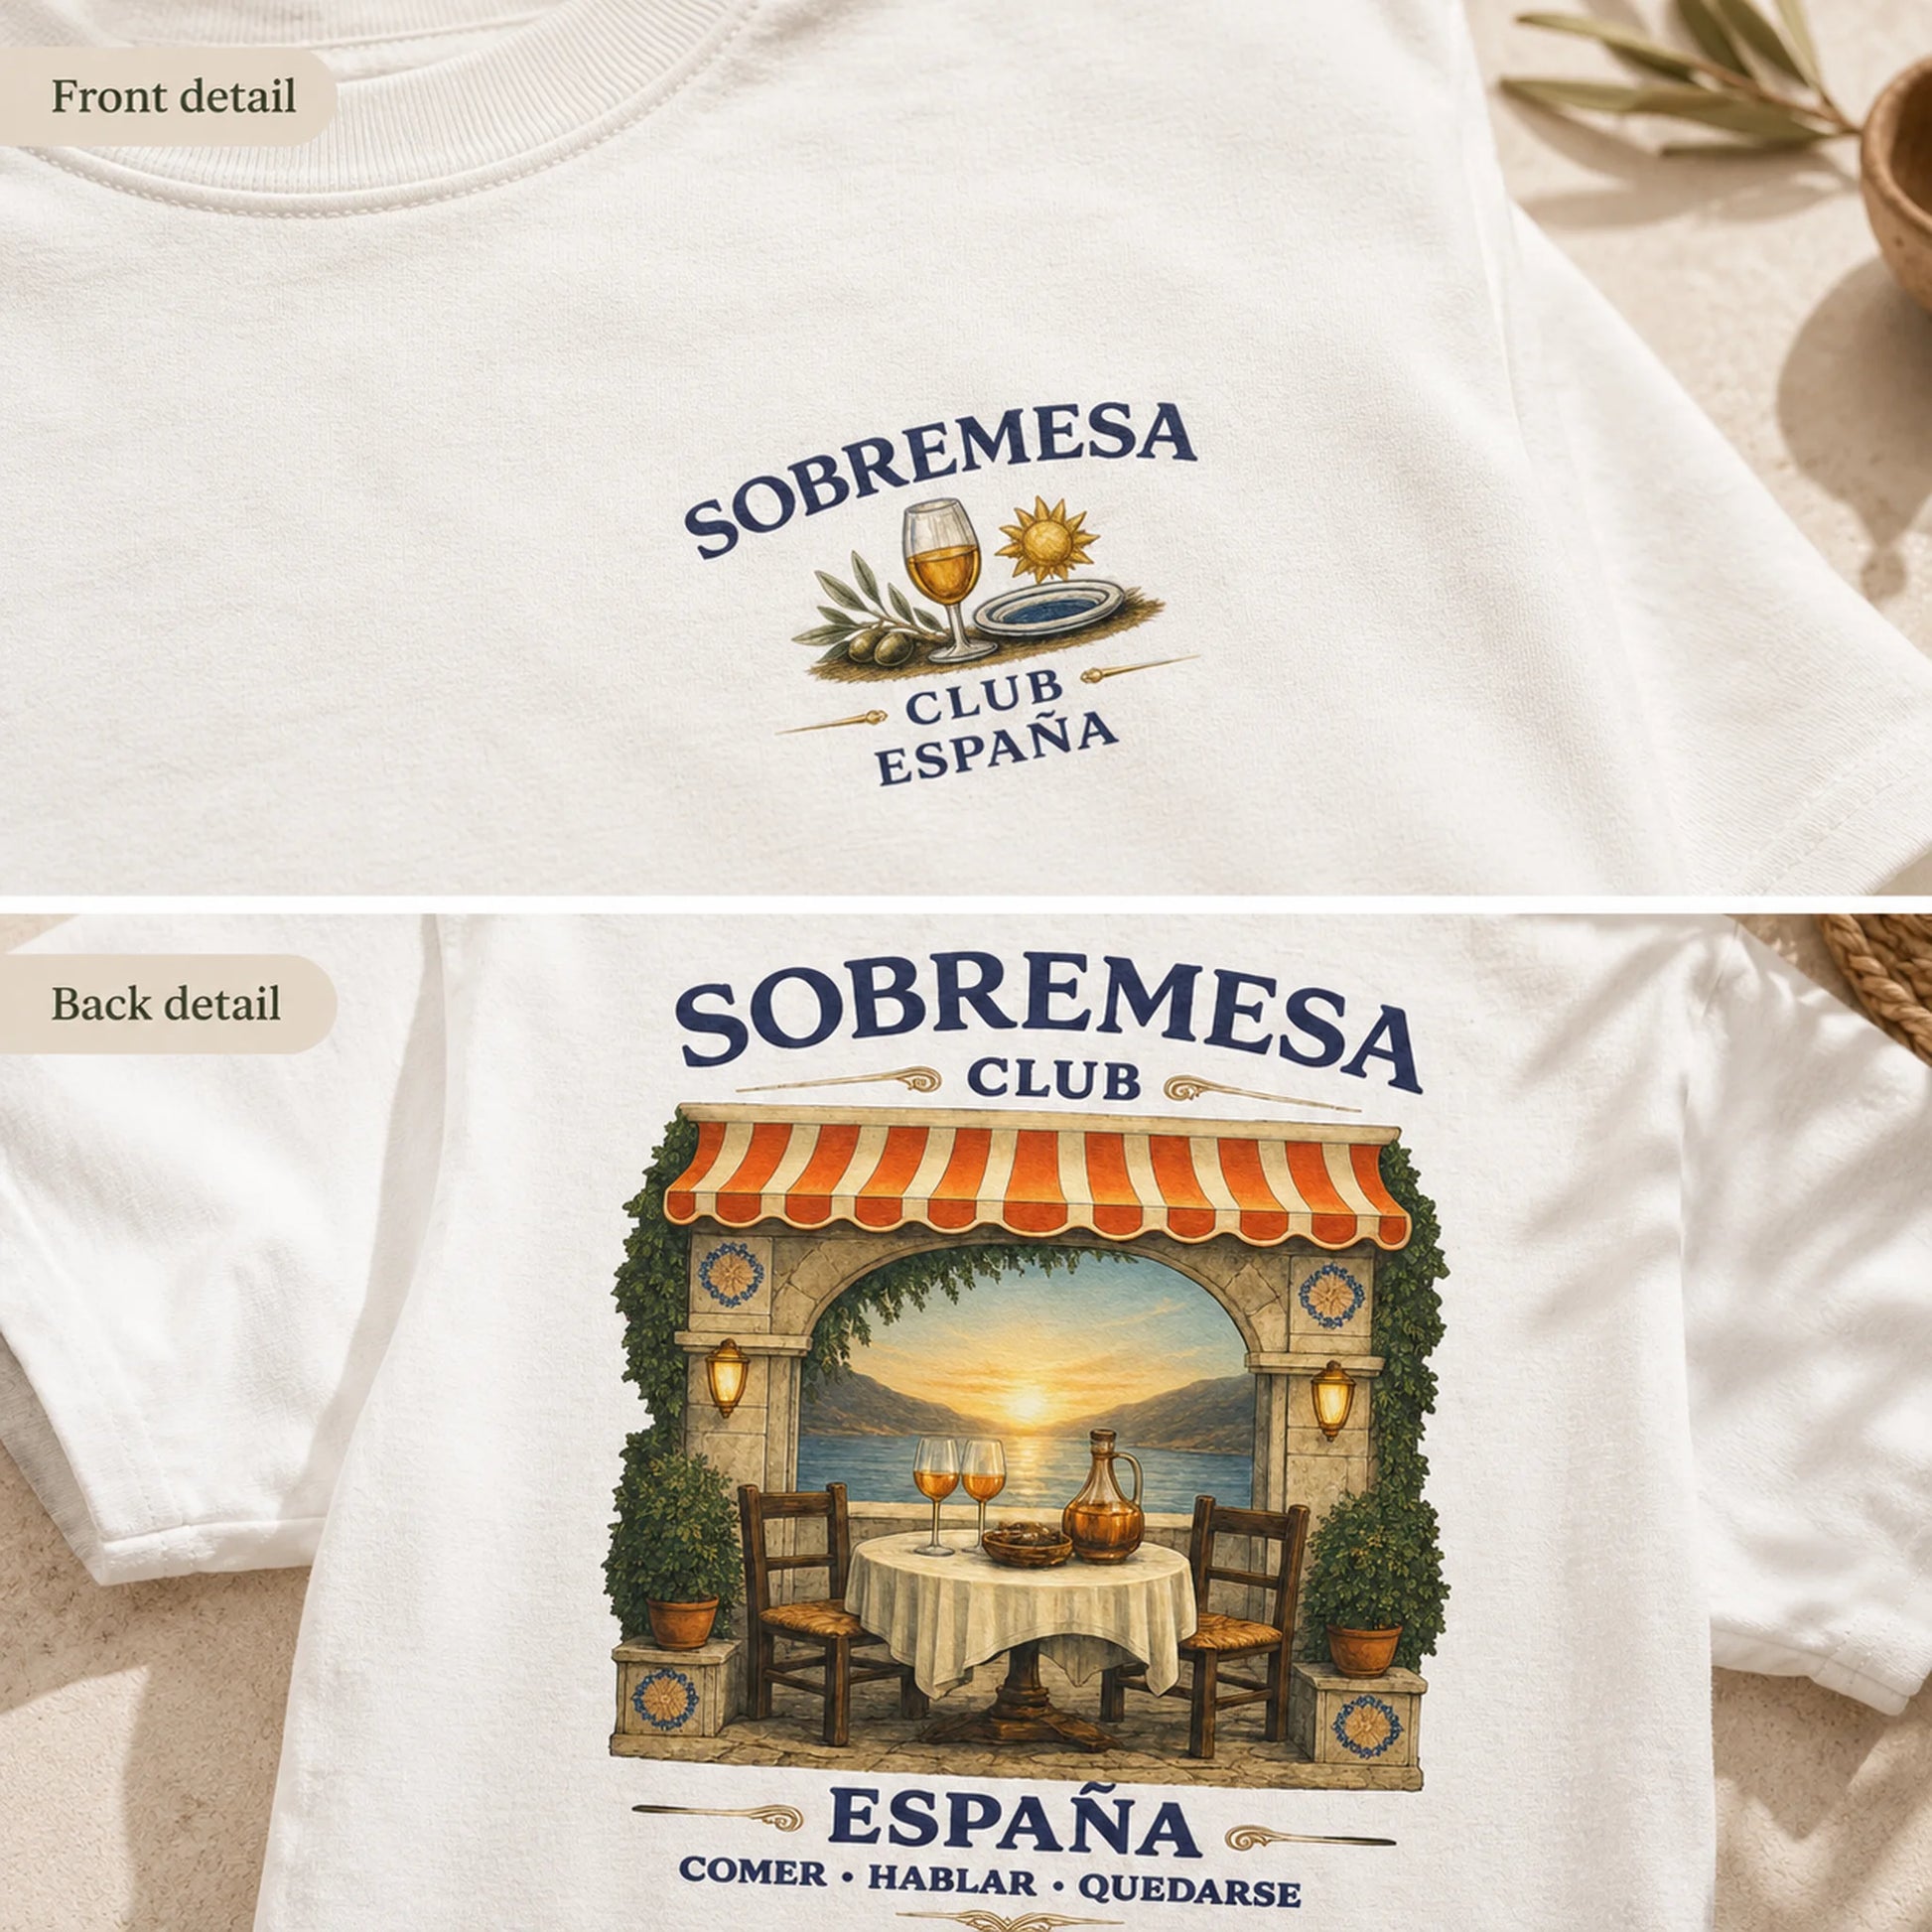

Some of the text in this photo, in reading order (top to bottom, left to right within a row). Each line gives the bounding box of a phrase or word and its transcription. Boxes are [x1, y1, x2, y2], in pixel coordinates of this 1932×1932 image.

[684, 401, 1197, 560] SOBREMESA
[905, 669, 1063, 726] CLUB
[875, 709, 1119, 787] ESPAÑA
[675, 950, 1424, 1095] SOBREMESA
[967, 1056, 1142, 1101] CLUB
[828, 1780, 1203, 1859] ESPAÑA
[679, 1856, 1302, 1908] COMER HABLAR QUEDARSE
